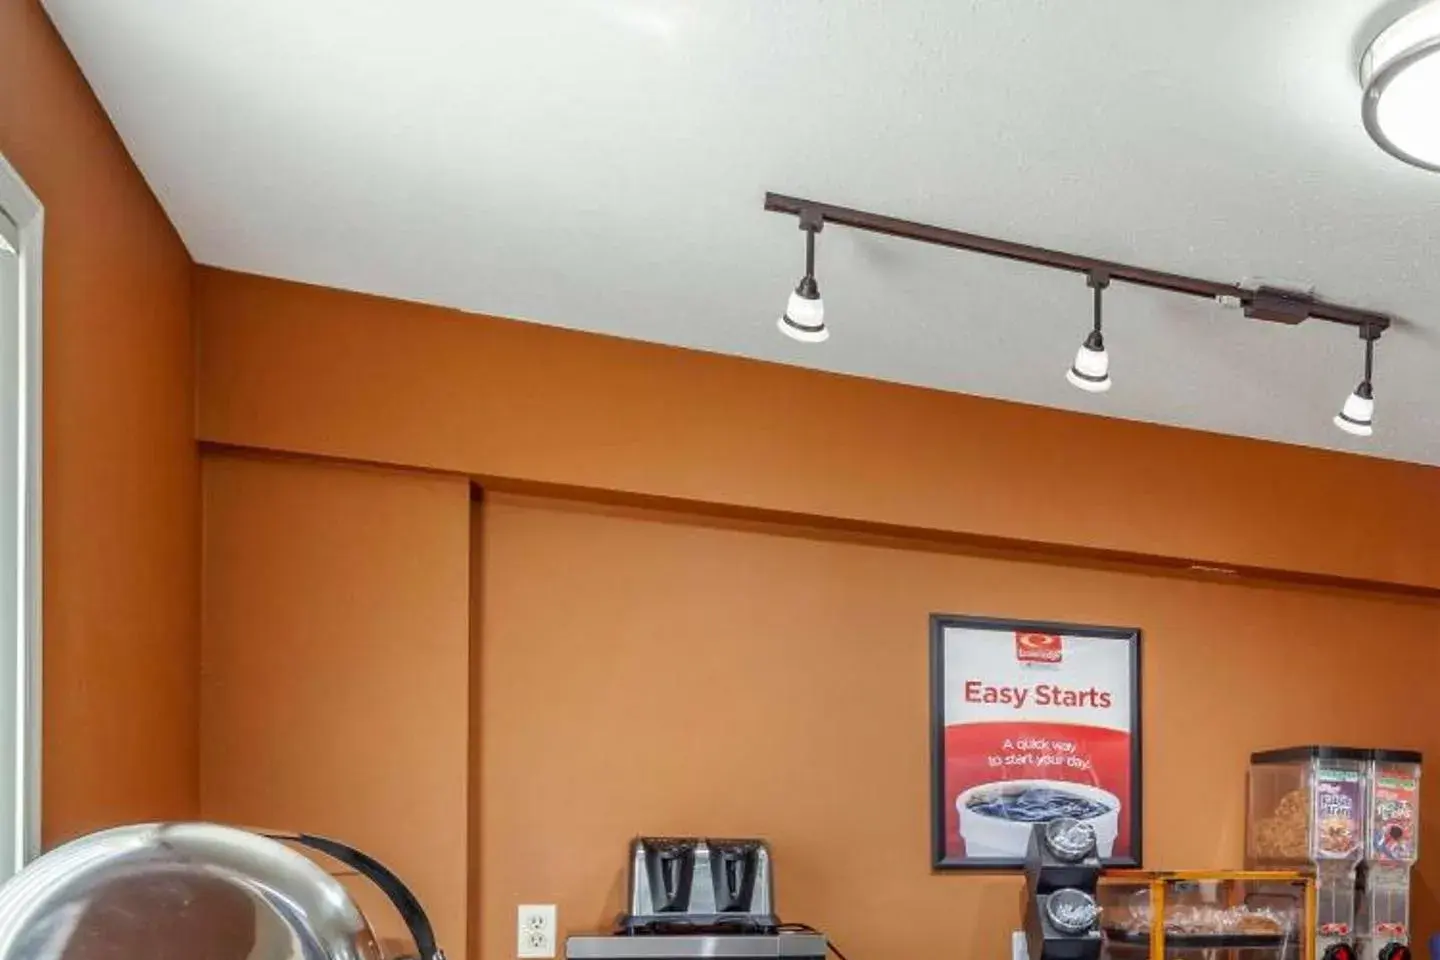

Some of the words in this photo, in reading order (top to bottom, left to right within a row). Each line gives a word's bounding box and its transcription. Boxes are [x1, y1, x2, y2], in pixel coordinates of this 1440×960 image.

[964, 680, 1027, 709] Easy
[1035, 684, 1112, 709] Starts
[1003, 738, 1014, 750] A
[1016, 737, 1050, 752] quick
[1051, 741, 1077, 754] way
[988, 755, 1002, 767] to
[1004, 754, 1034, 766] start
[1036, 754, 1064, 767] your
